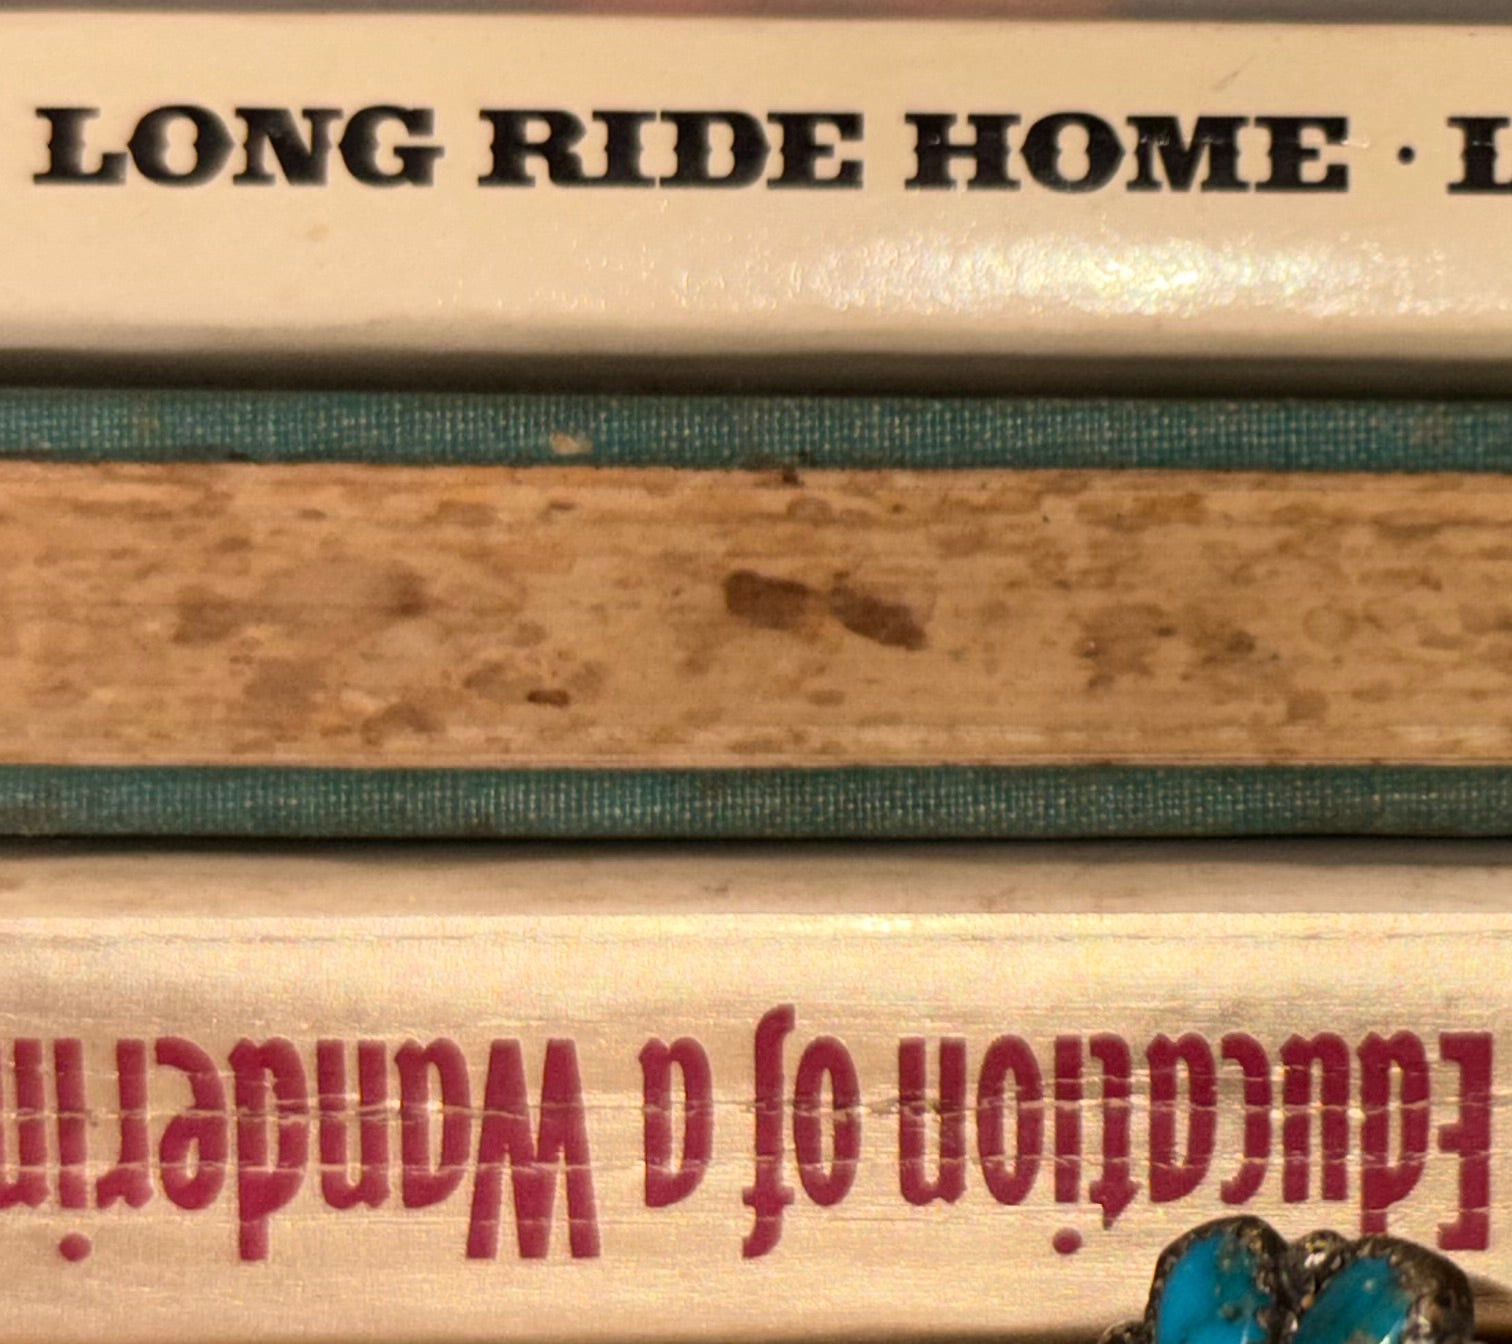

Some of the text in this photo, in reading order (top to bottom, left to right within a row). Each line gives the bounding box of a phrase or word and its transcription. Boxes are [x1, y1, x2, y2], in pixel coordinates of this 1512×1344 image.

[33, 105, 444, 186] LONG
[478, 109, 864, 189] RIDE
[904, 111, 1349, 193] HOME
[638, 1036, 714, 1208] a
[741, 1003, 862, 1259] of
[897, 1029, 1494, 1255] Education
